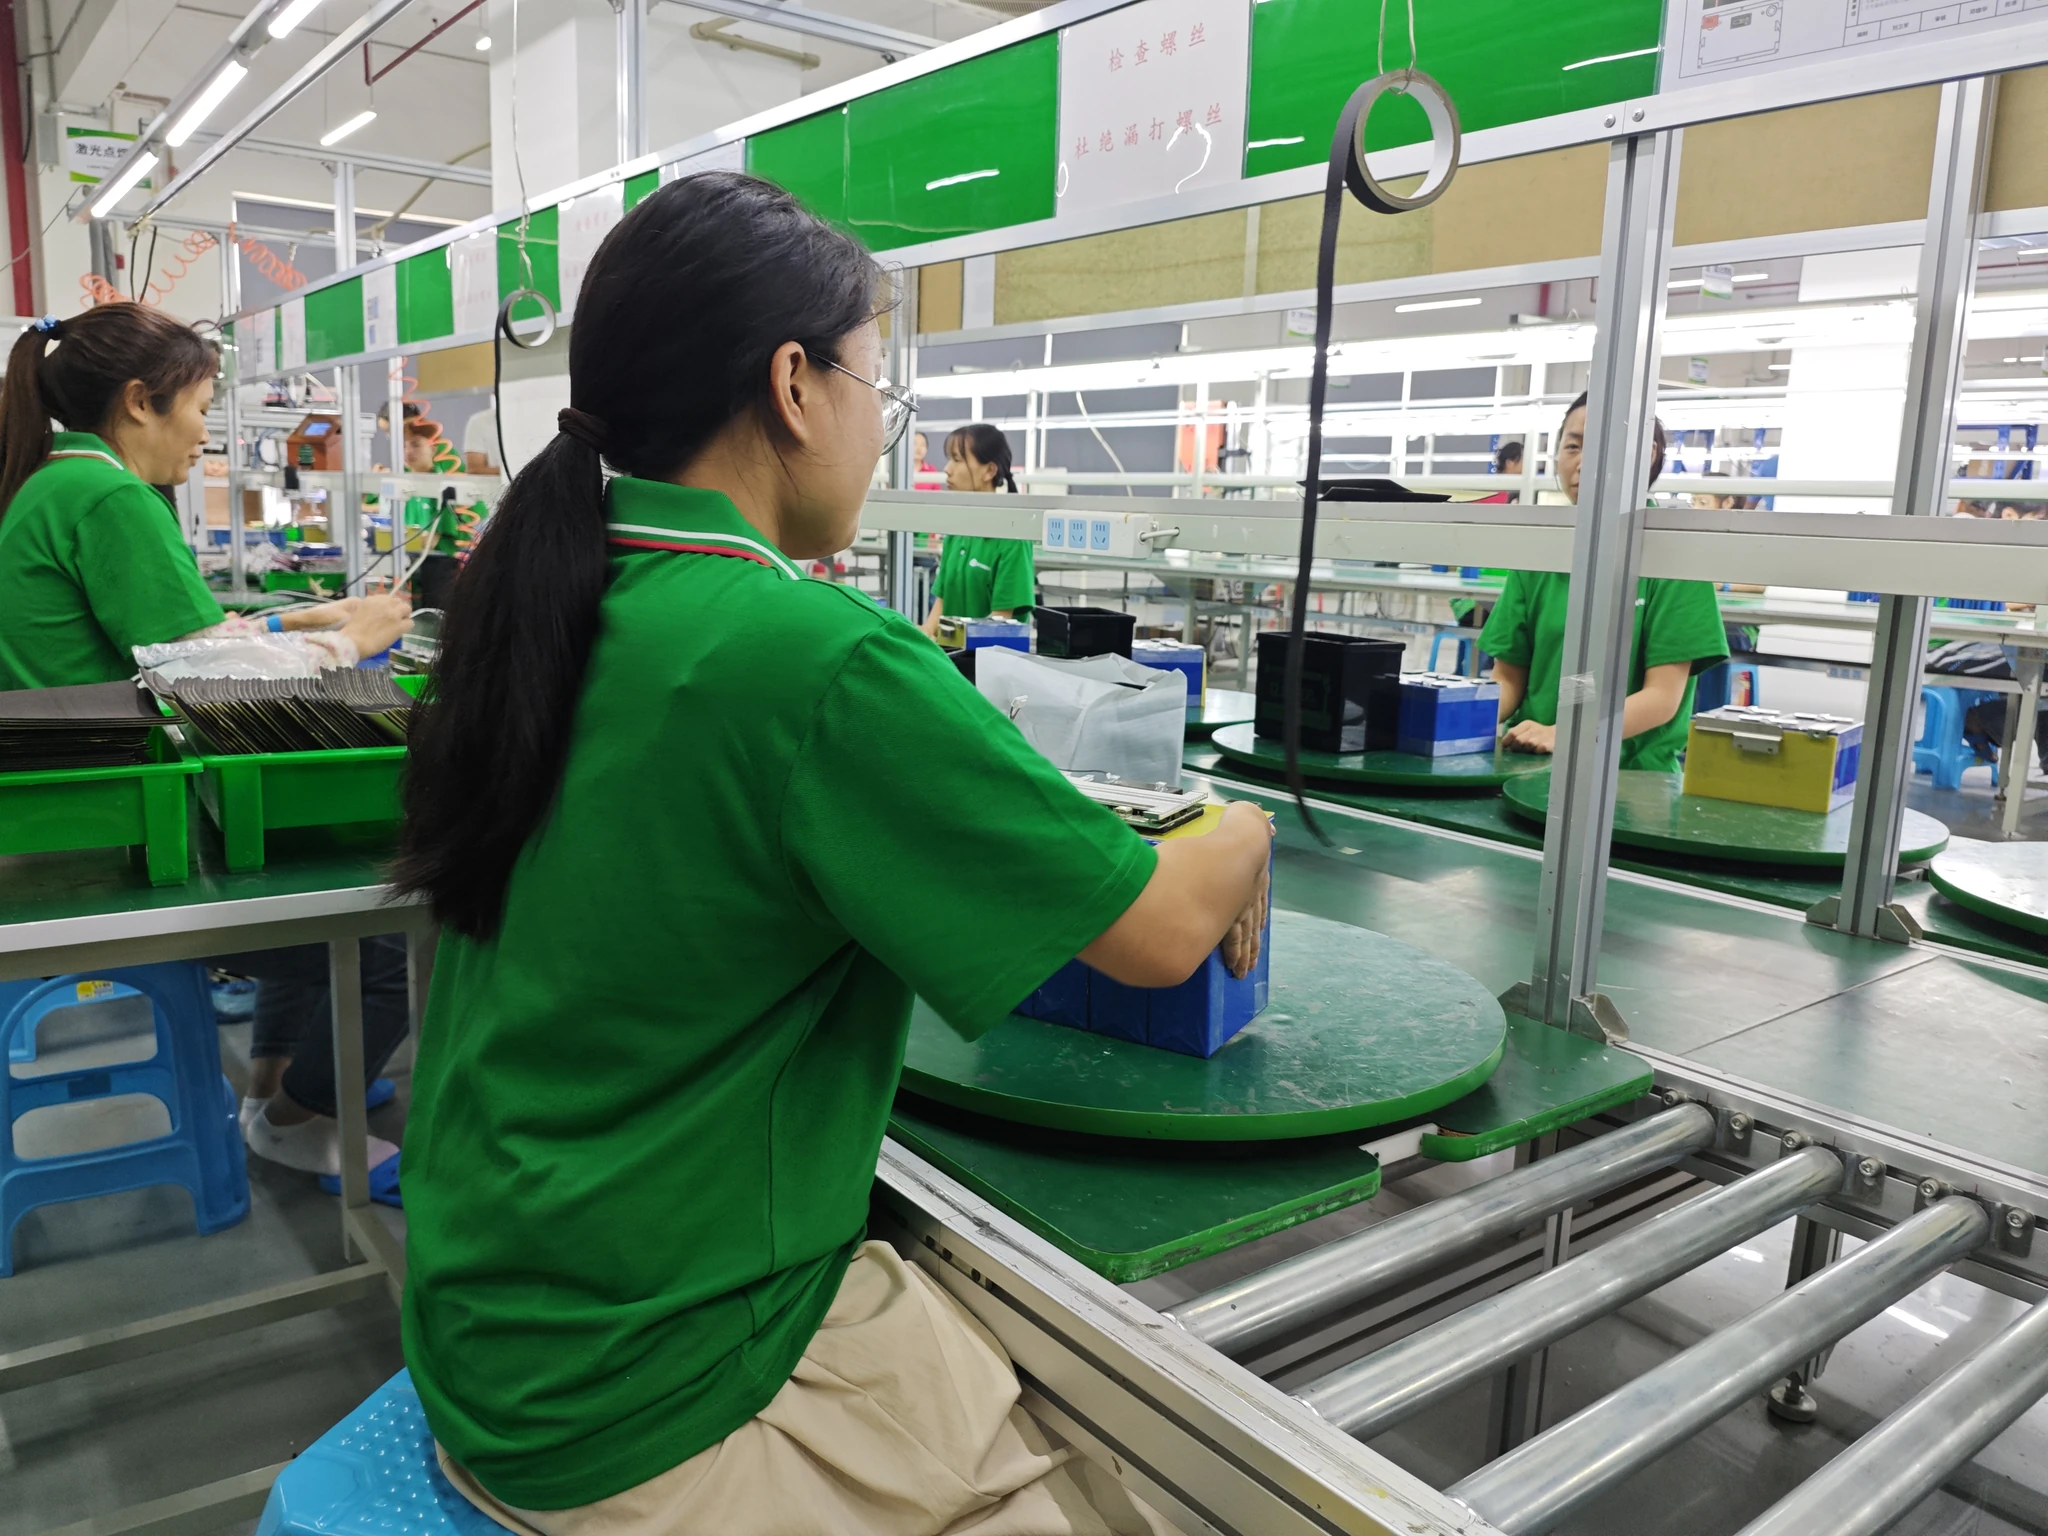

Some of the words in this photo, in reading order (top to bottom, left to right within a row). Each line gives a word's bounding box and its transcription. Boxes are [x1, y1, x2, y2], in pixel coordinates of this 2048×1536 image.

[1108, 22, 1207, 73] 检查螺丝
[1074, 102, 1223, 160] 杜绝漏打螺丝
